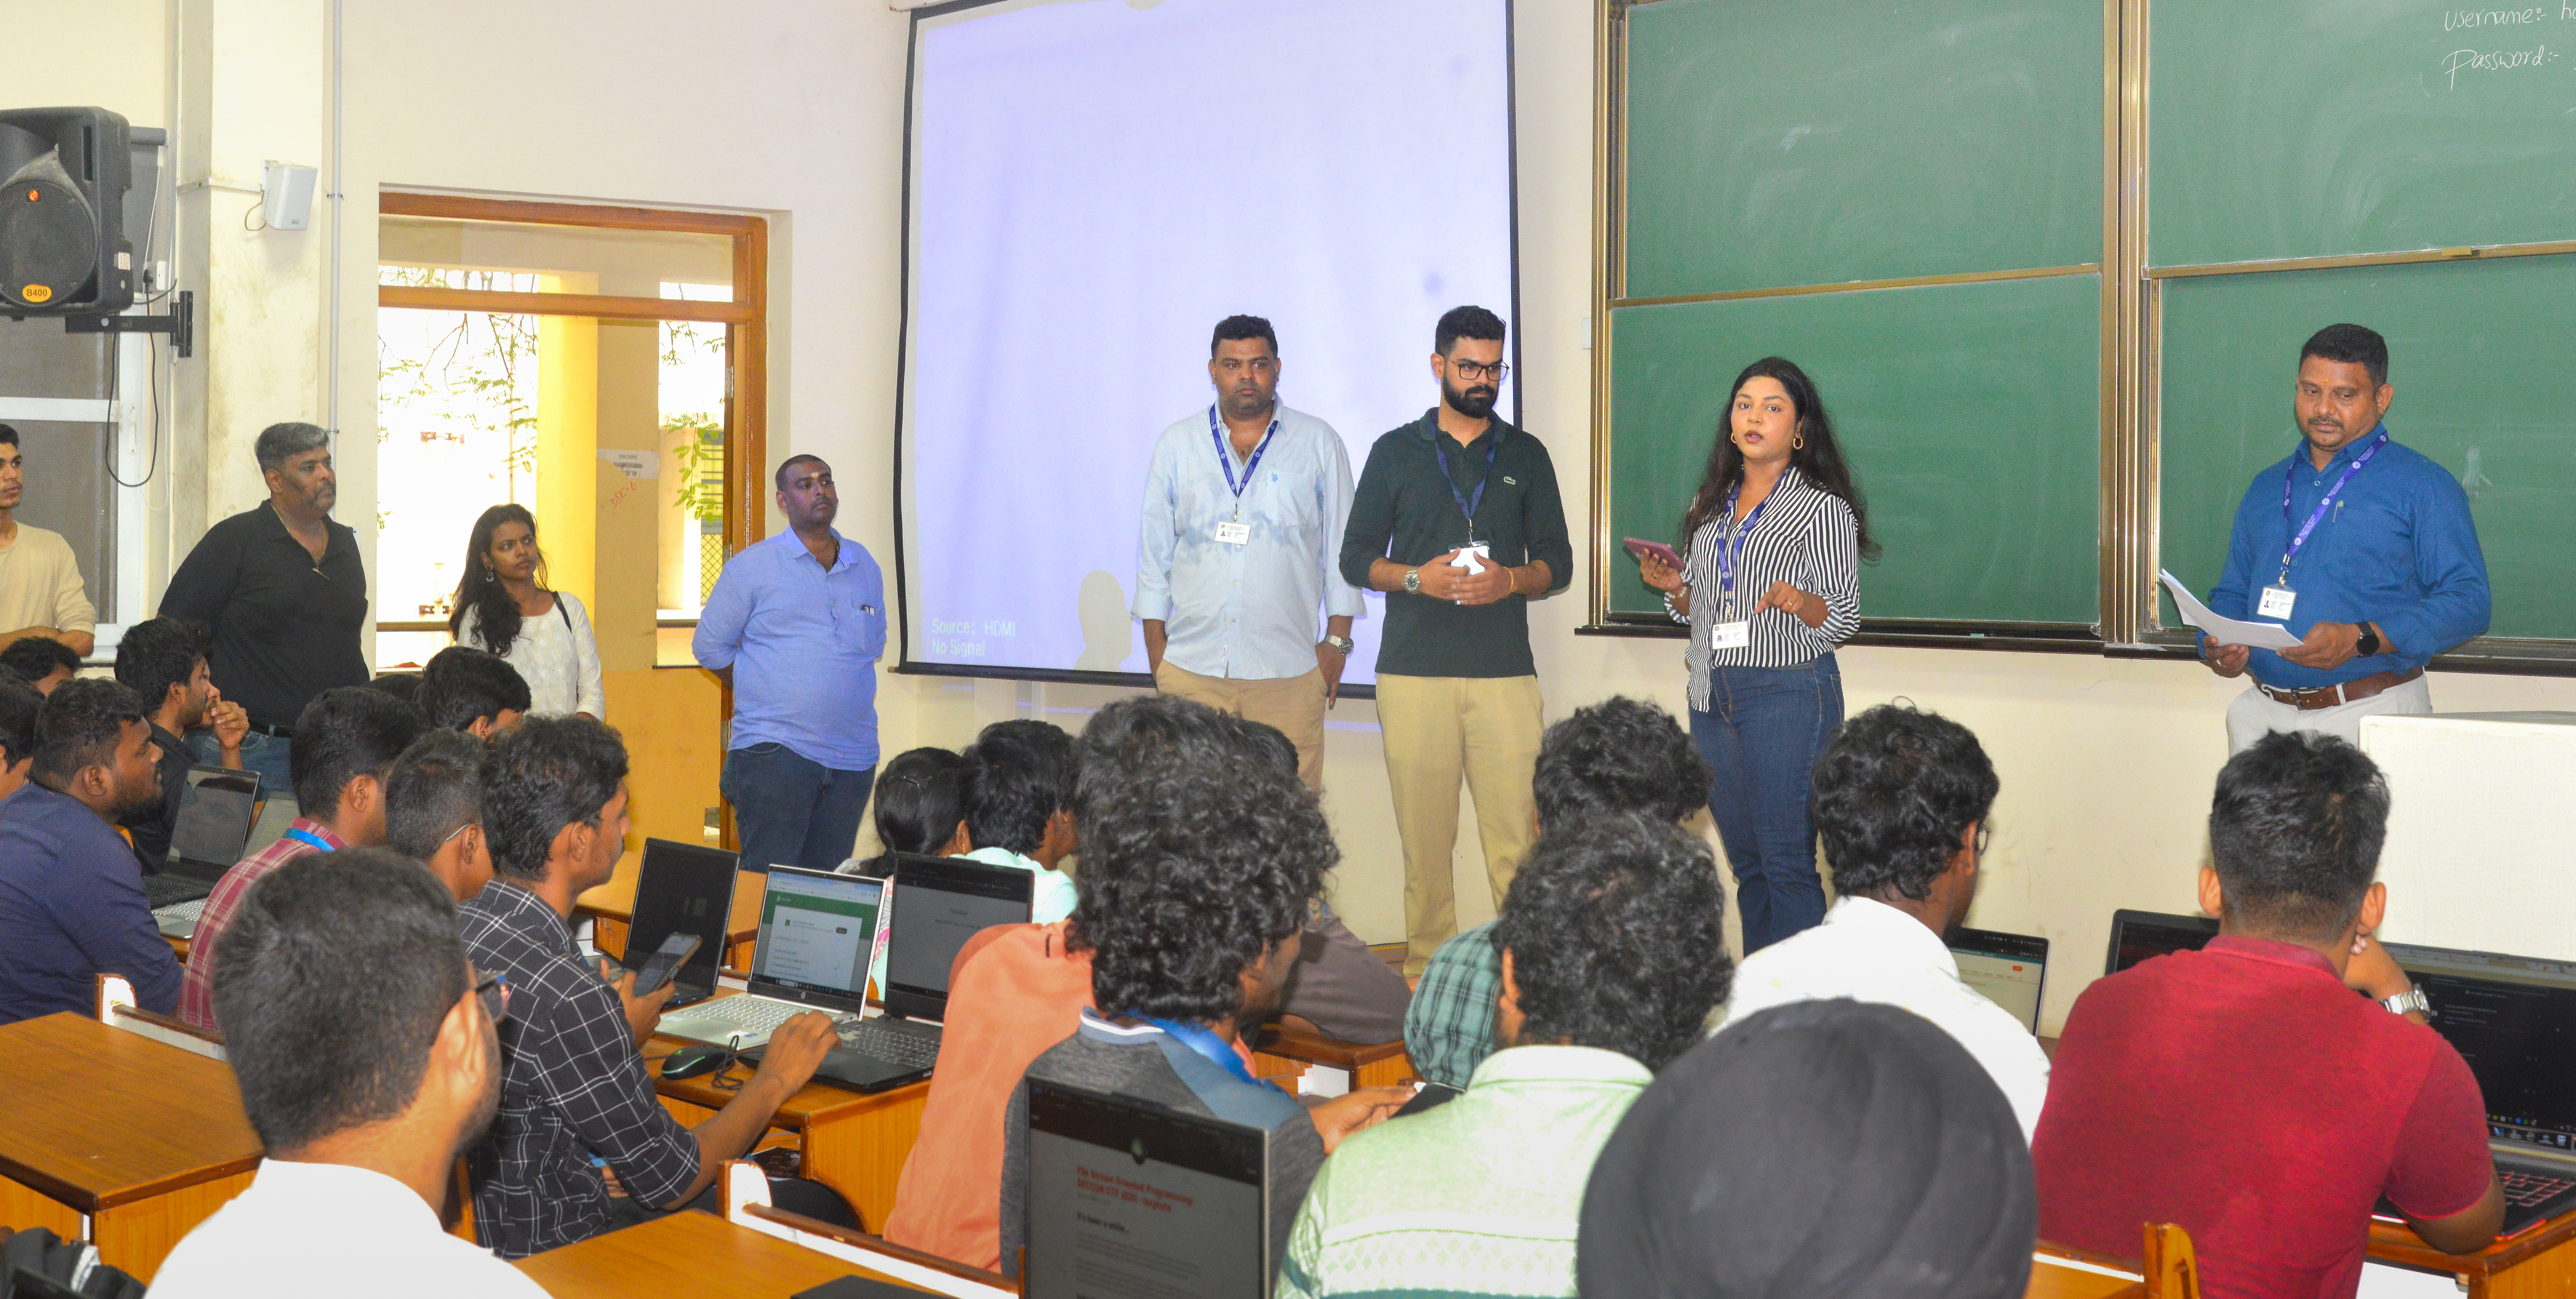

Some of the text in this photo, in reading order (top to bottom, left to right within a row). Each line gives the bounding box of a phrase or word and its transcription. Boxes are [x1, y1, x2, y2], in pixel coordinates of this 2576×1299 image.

[932, 618, 1016, 637] Source: HDMI
[932, 638, 985, 657] No Signal
